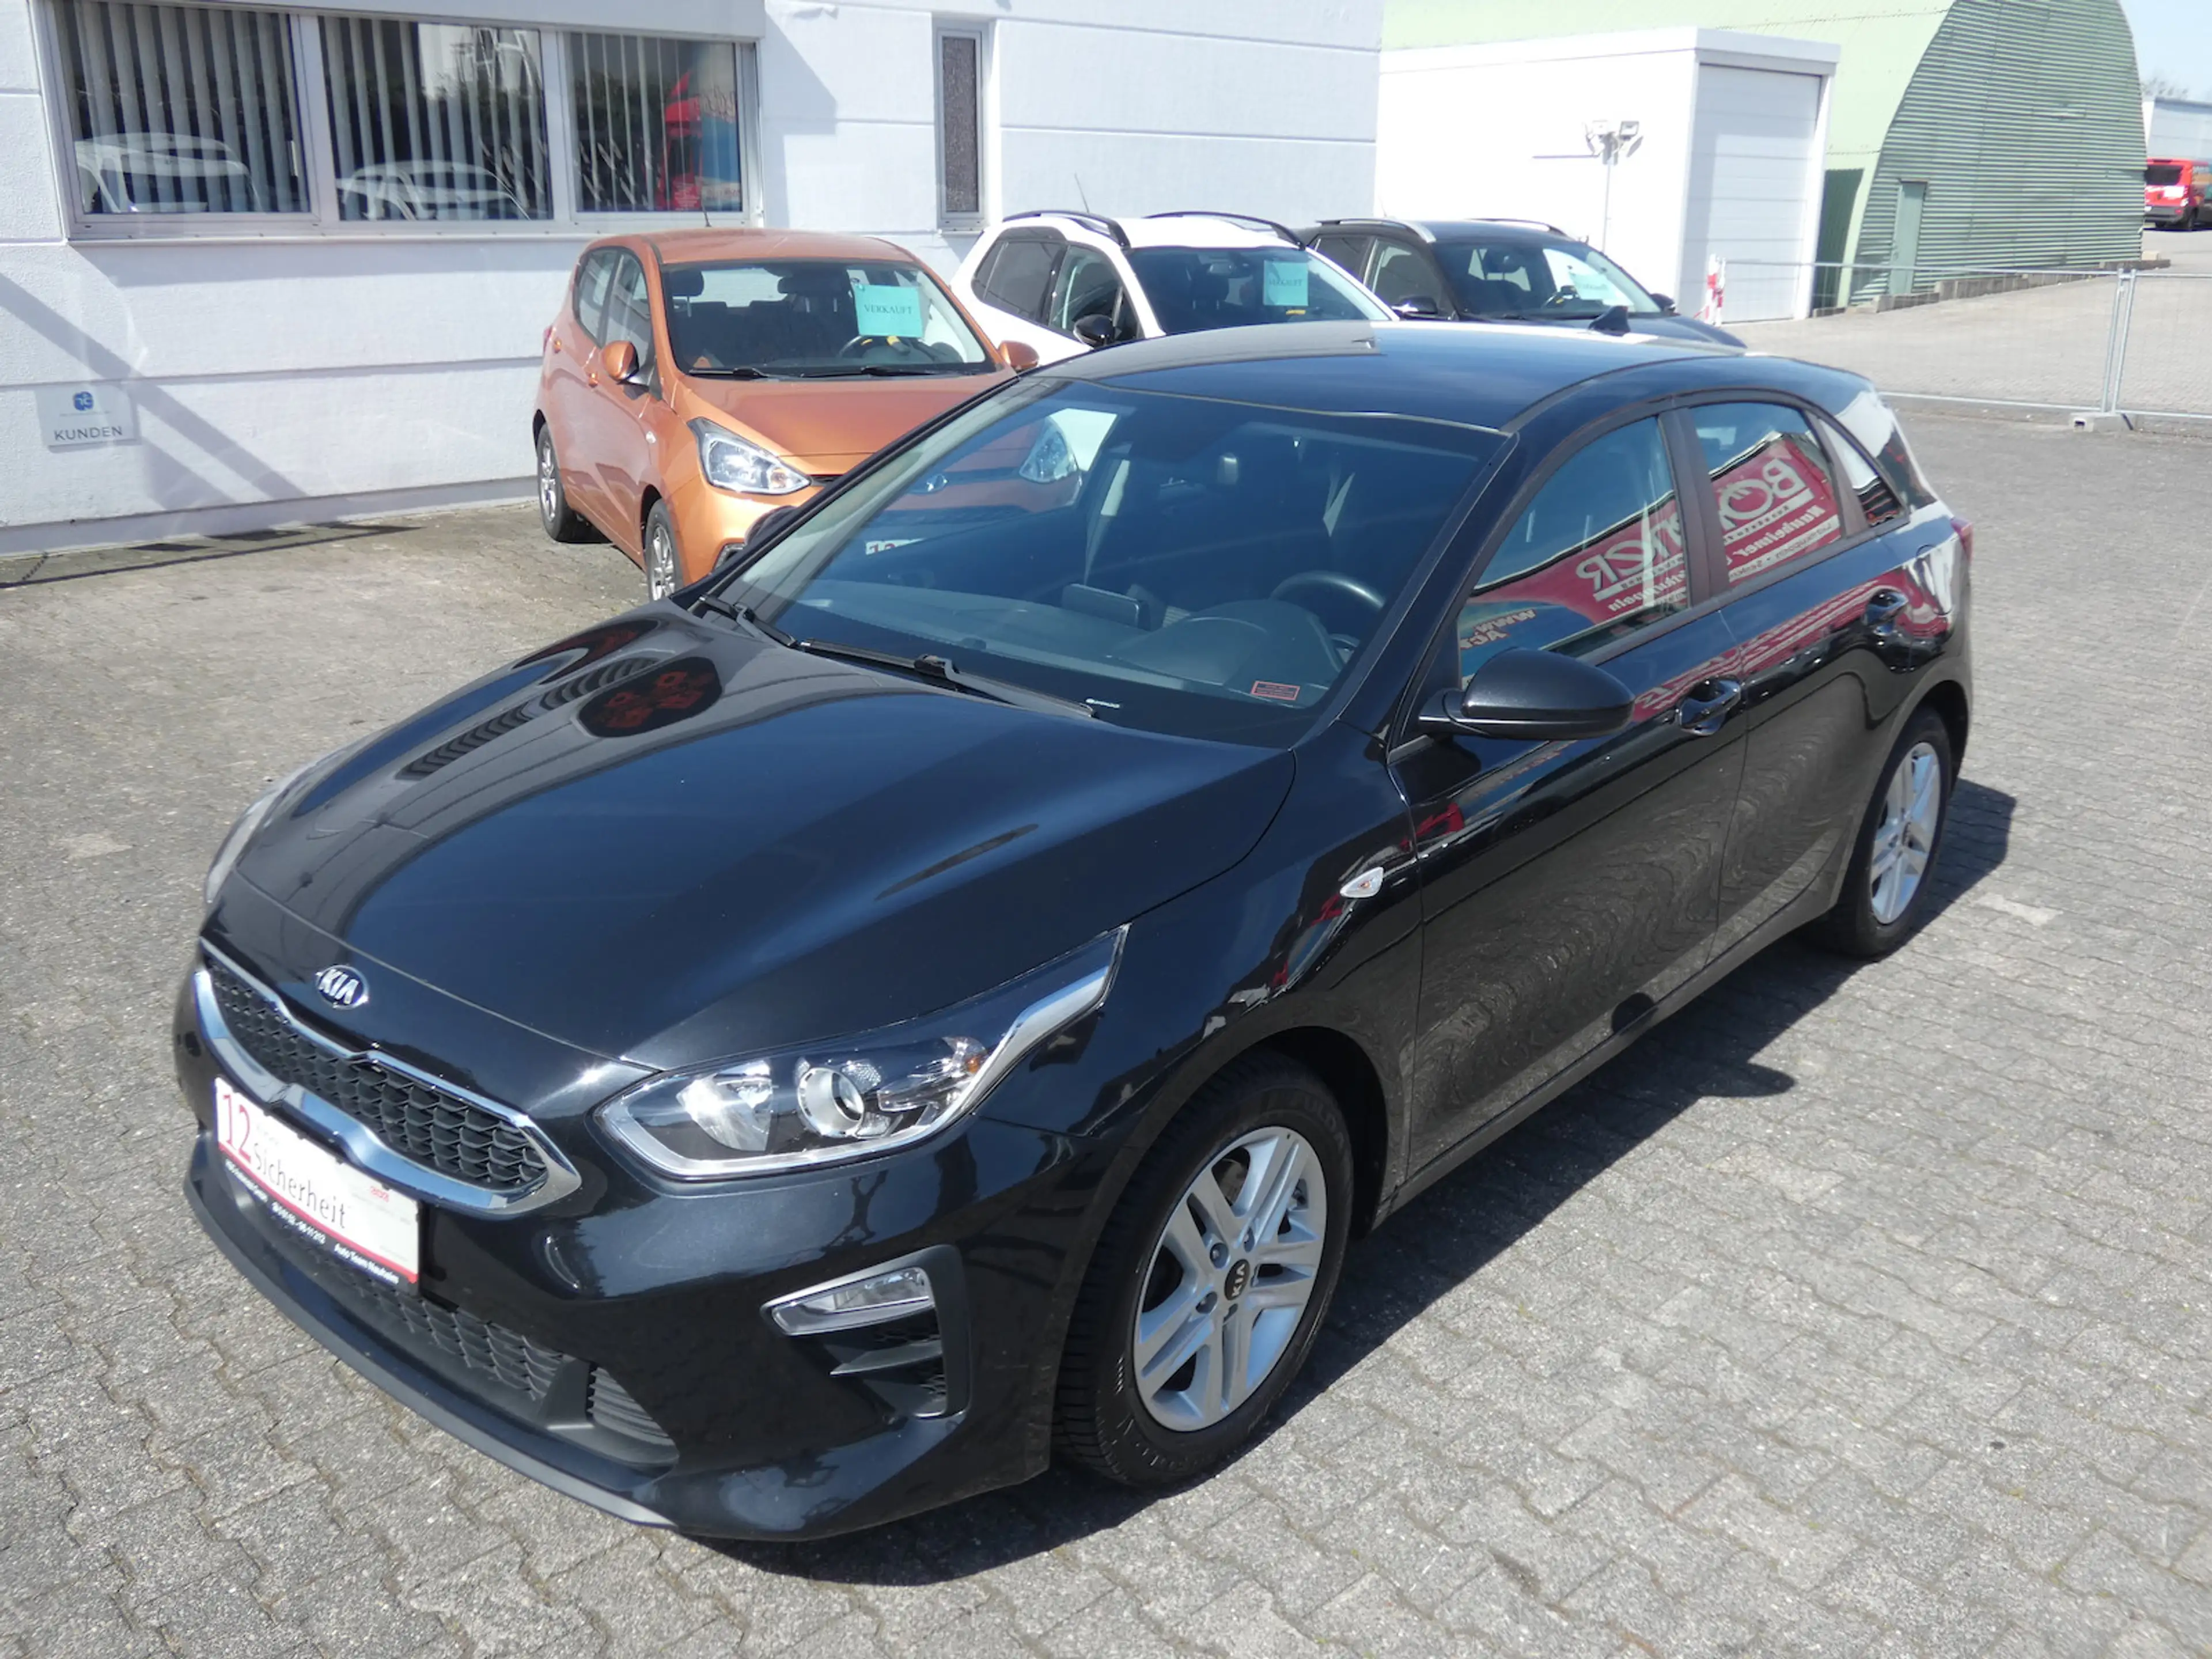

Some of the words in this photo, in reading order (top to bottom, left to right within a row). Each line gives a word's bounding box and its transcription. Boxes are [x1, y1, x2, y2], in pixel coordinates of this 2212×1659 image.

[863, 304, 913, 316] VERKAUFT
[54, 426, 123, 441] KUNDEN
[318, 969, 359, 1005] KIA
[222, 1094, 252, 1164] 12
[253, 1143, 347, 1229] Sicherheit
[1231, 1263, 1246, 1297] KIA
